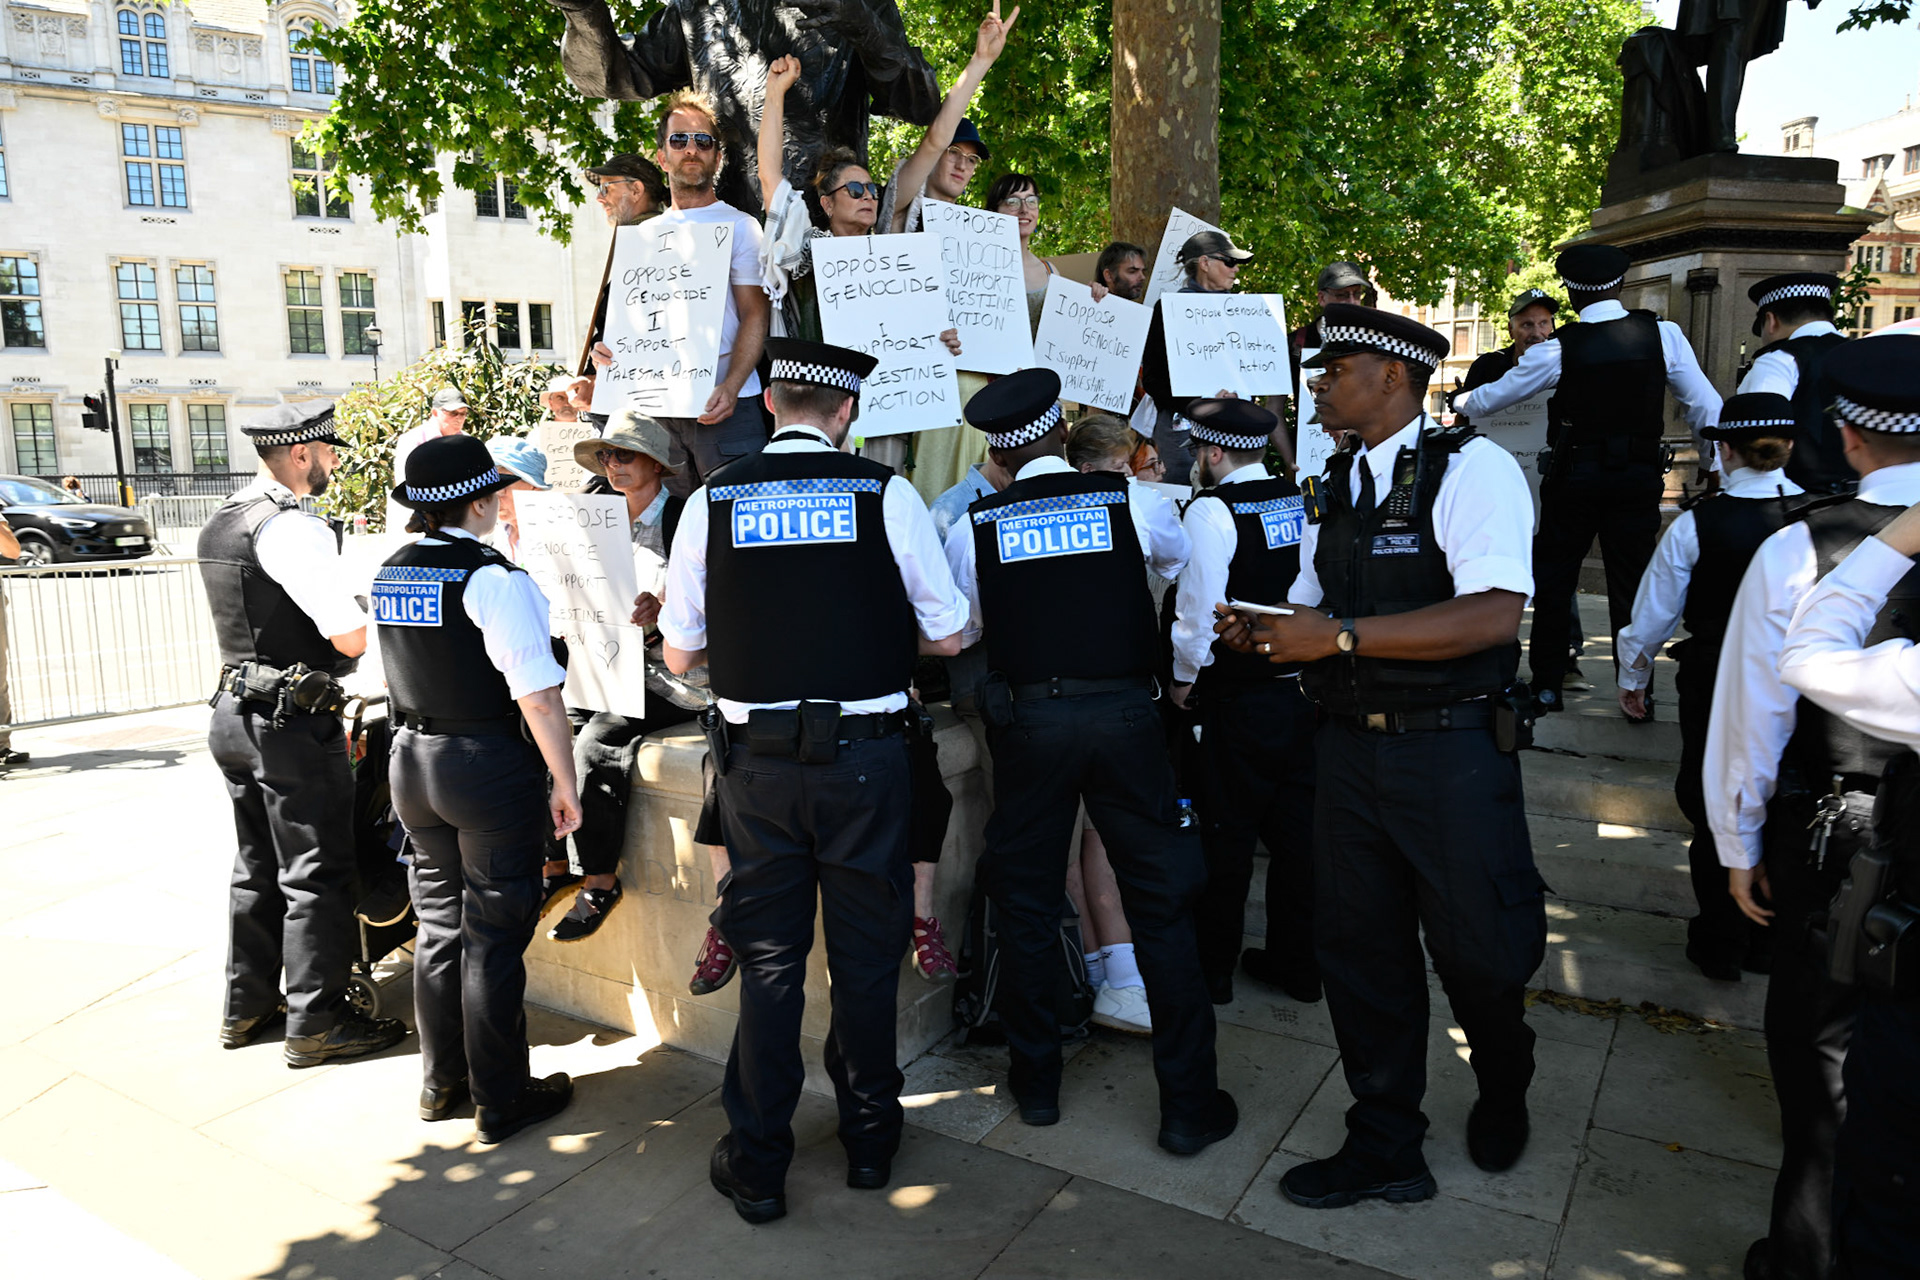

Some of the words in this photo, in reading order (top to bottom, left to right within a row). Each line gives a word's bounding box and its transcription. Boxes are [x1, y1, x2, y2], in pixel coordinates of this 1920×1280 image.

[925, 203, 937, 222] I
[943, 207, 1006, 235] OPPOSE
[1169, 214, 1183, 232] I
[658, 231, 674, 253] I
[866, 236, 874, 255] I
[941, 237, 1019, 272] ENOCIDE
[623, 263, 692, 285] OPPOSE
[822, 253, 916, 279] OPPOSE
[950, 269, 1018, 294] SUPPORT
[625, 286, 712, 306] GENOCIDE
[823, 276, 940, 310] GENOCIDE
[1055, 294, 1068, 316] I
[648, 310, 664, 332] I
[879, 322, 888, 337] I
[948, 308, 1005, 331] ACTION
[846, 334, 936, 354] UPPORT
[1044, 340, 1056, 361] I
[1225, 331, 1277, 353] Palestine
[1239, 356, 1276, 373] Action
[868, 389, 945, 412] ACTION
[559, 428, 594, 440] OPPOS
[737, 498, 850, 512] METROPOLITAN
[737, 509, 851, 542] POLICE
[1002, 511, 1105, 531] METROPOLITAN
[1264, 510, 1304, 524] METROPO
[1002, 522, 1108, 558] POLICE
[1267, 520, 1302, 545] POL
[371, 595, 438, 622] POLICE
